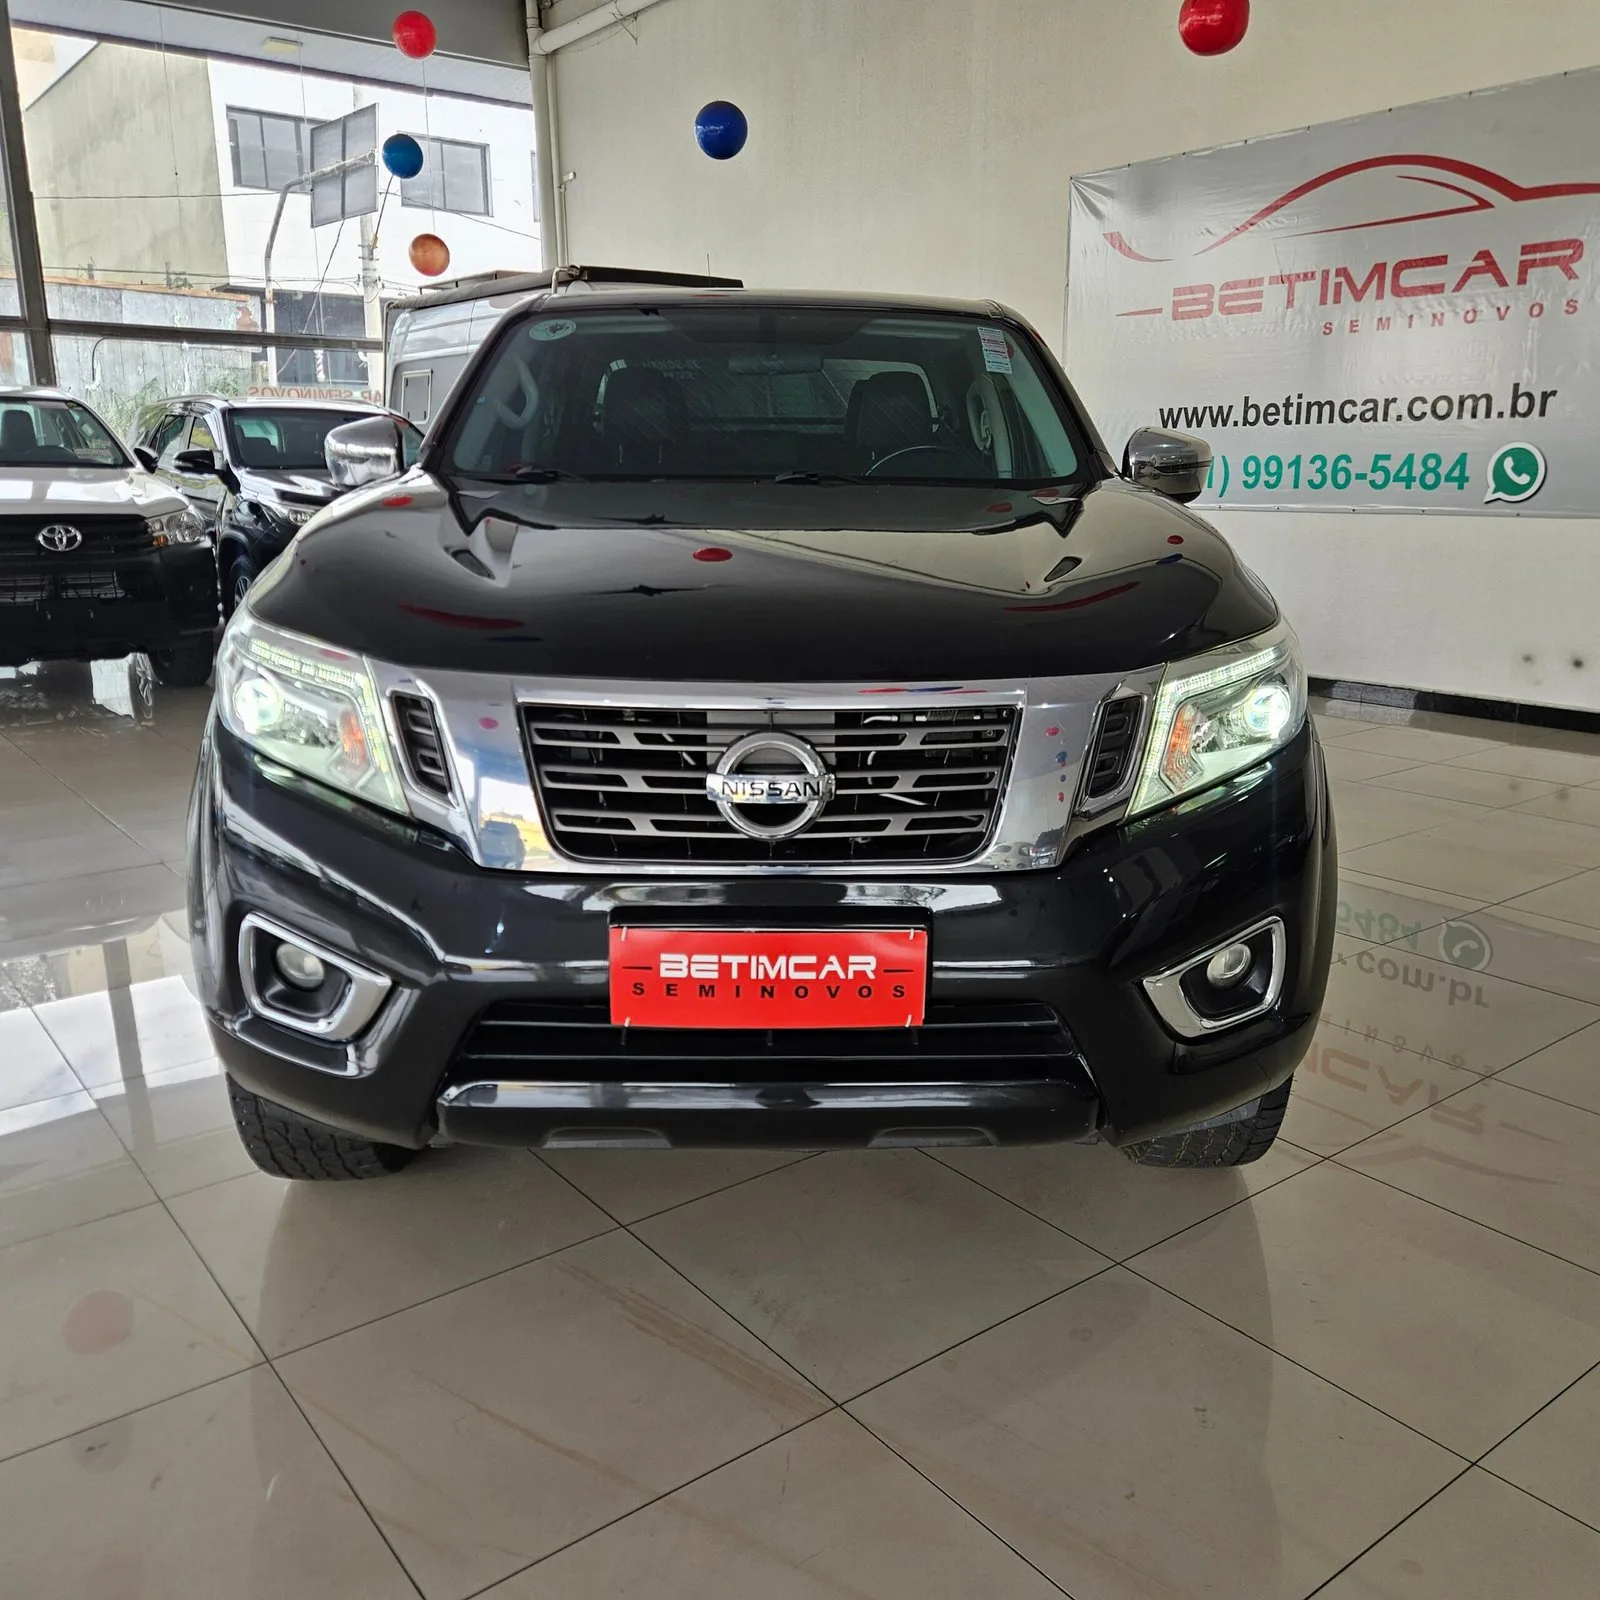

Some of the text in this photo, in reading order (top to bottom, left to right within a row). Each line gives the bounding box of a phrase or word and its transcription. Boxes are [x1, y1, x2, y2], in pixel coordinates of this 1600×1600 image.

[1171, 238, 1584, 321] BETIMCAR
[1322, 299, 1579, 336] SEMINOVOS
[1159, 382, 1558, 430] www.betimcar.com.br
[1242, 452, 1470, 492] 99136-5484
[721, 779, 822, 797] NISSAN
[659, 953, 877, 980] BETIMCAR
[631, 983, 905, 998] SEMINOVOS
